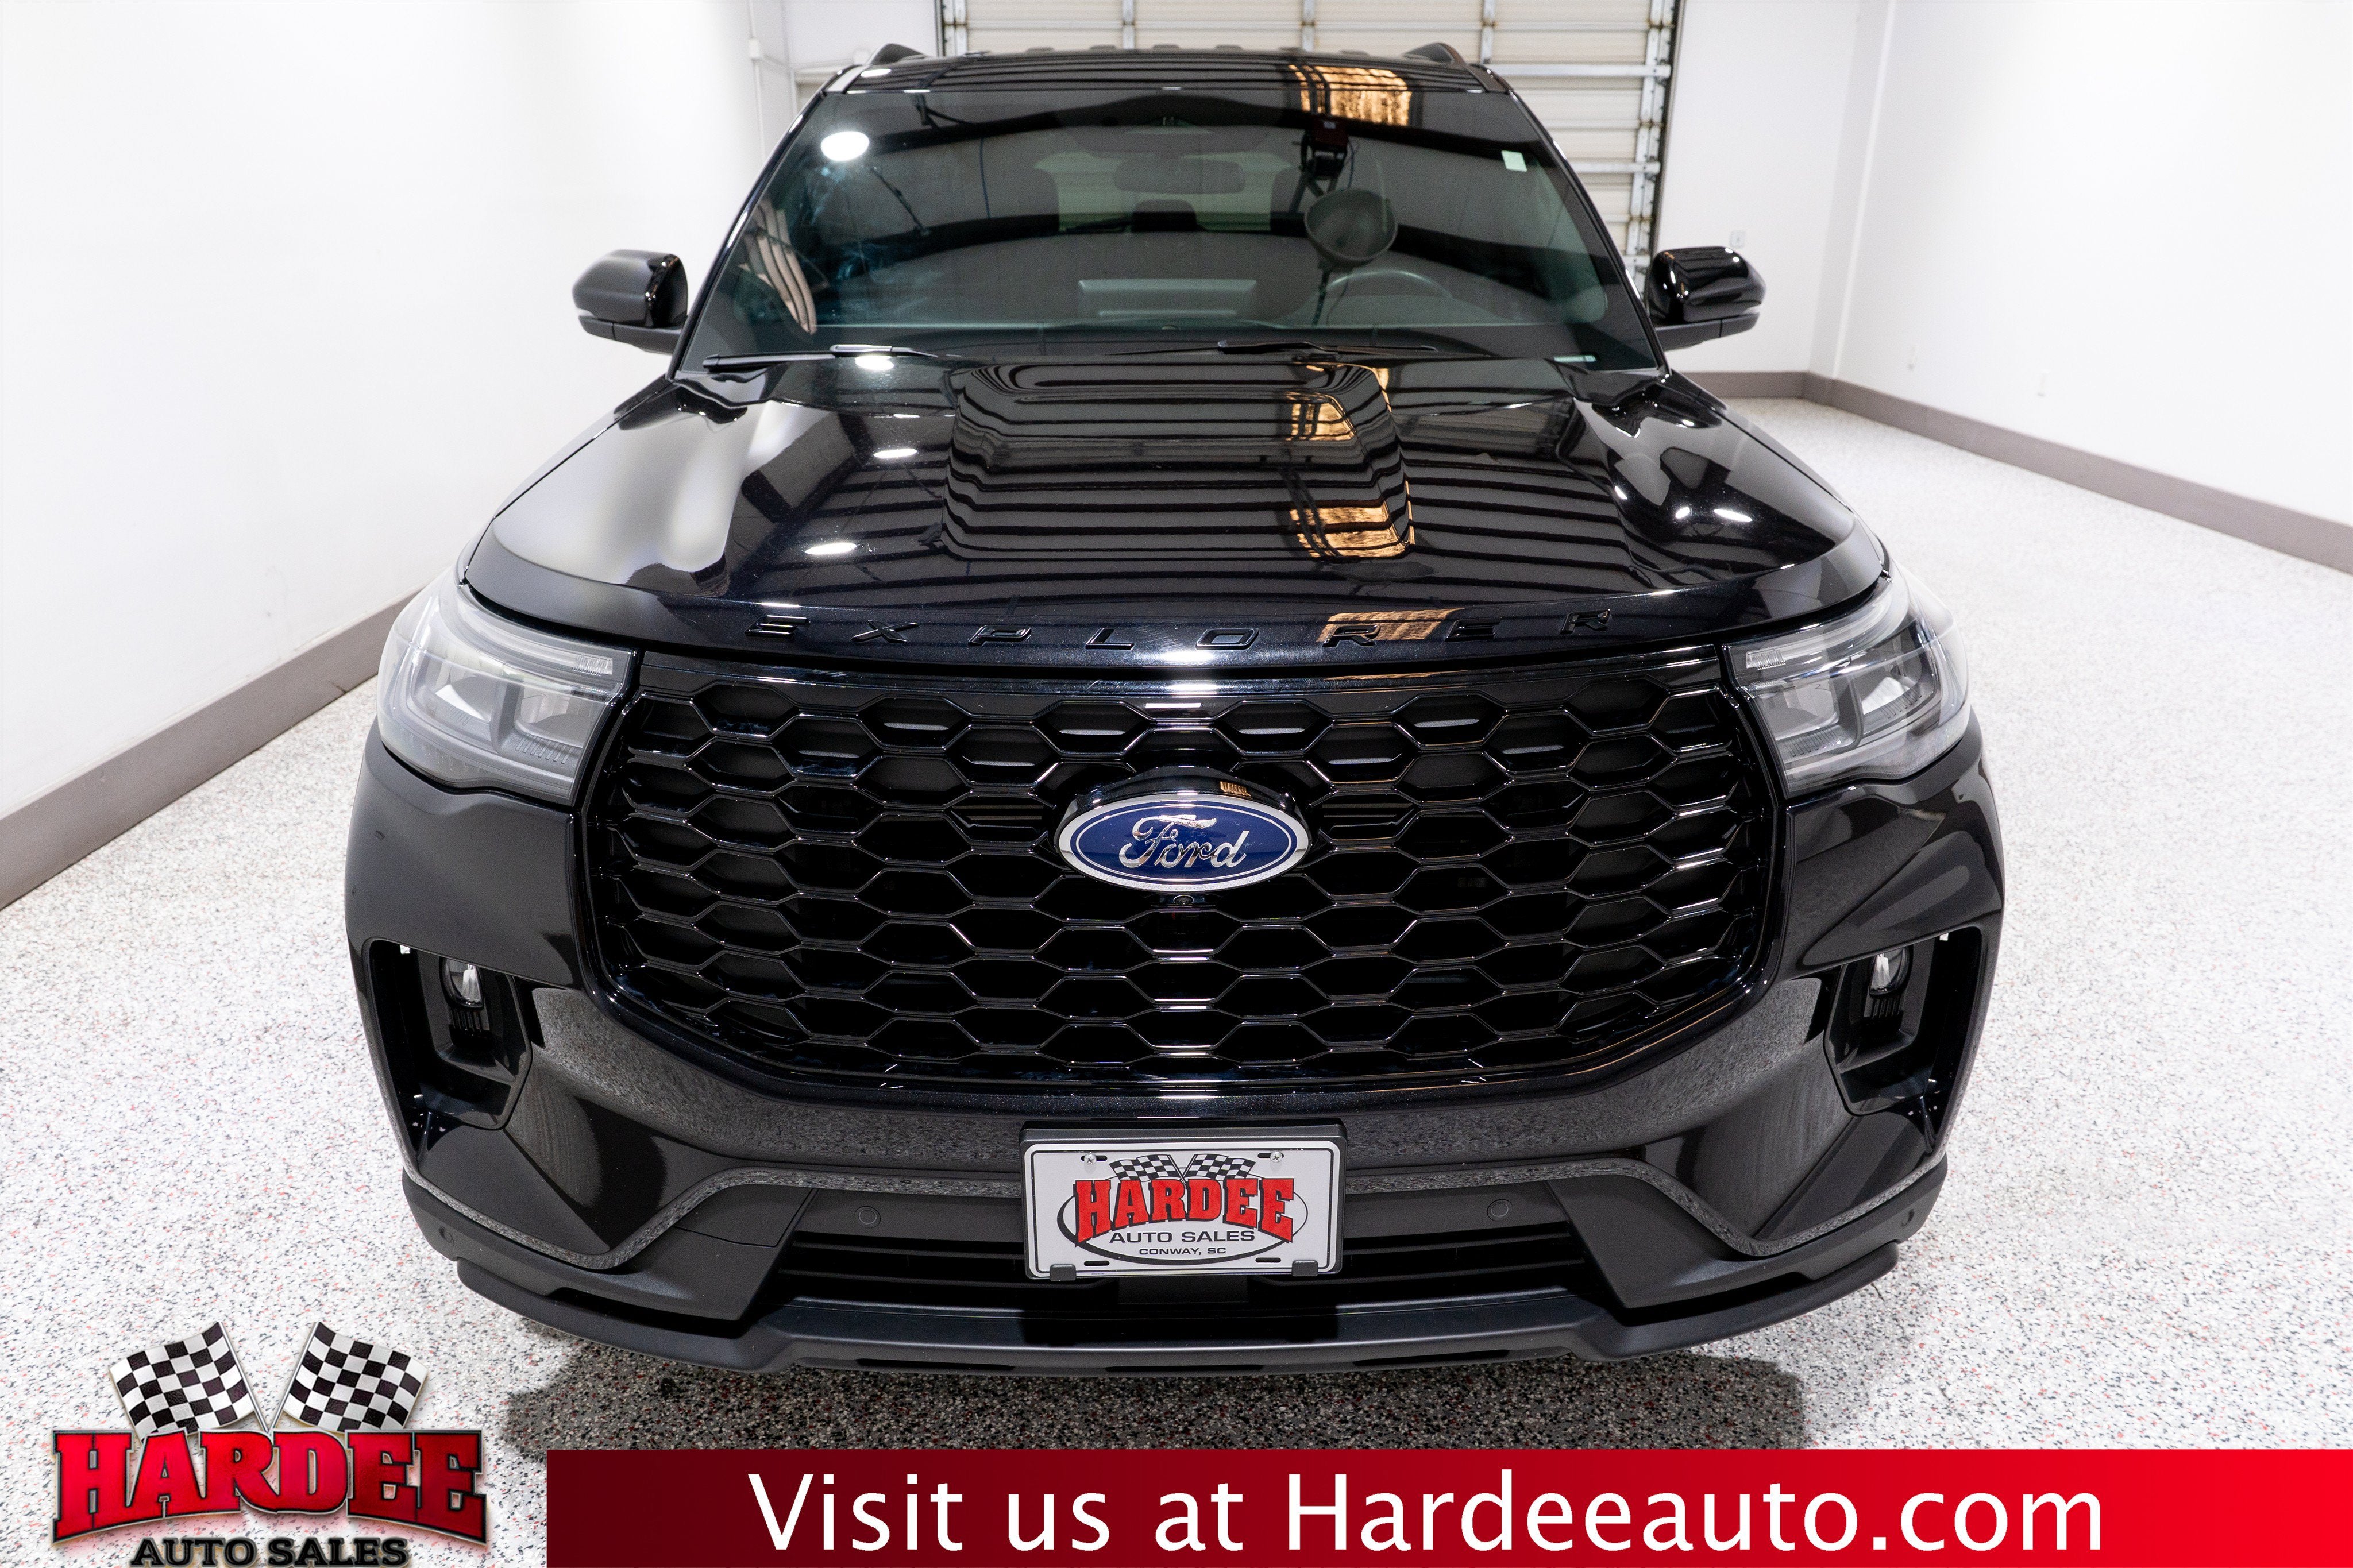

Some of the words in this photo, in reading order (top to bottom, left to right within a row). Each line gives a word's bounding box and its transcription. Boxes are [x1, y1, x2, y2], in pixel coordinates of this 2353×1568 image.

[745, 609, 1612, 651] EXPLORER
[1118, 814, 1250, 868] Ford
[1073, 1177, 1295, 1248] HARDEE
[1109, 1231, 1173, 1244] AUTO
[1181, 1230, 1255, 1242] SALES
[1139, 1248, 1202, 1256] CONWAY,
